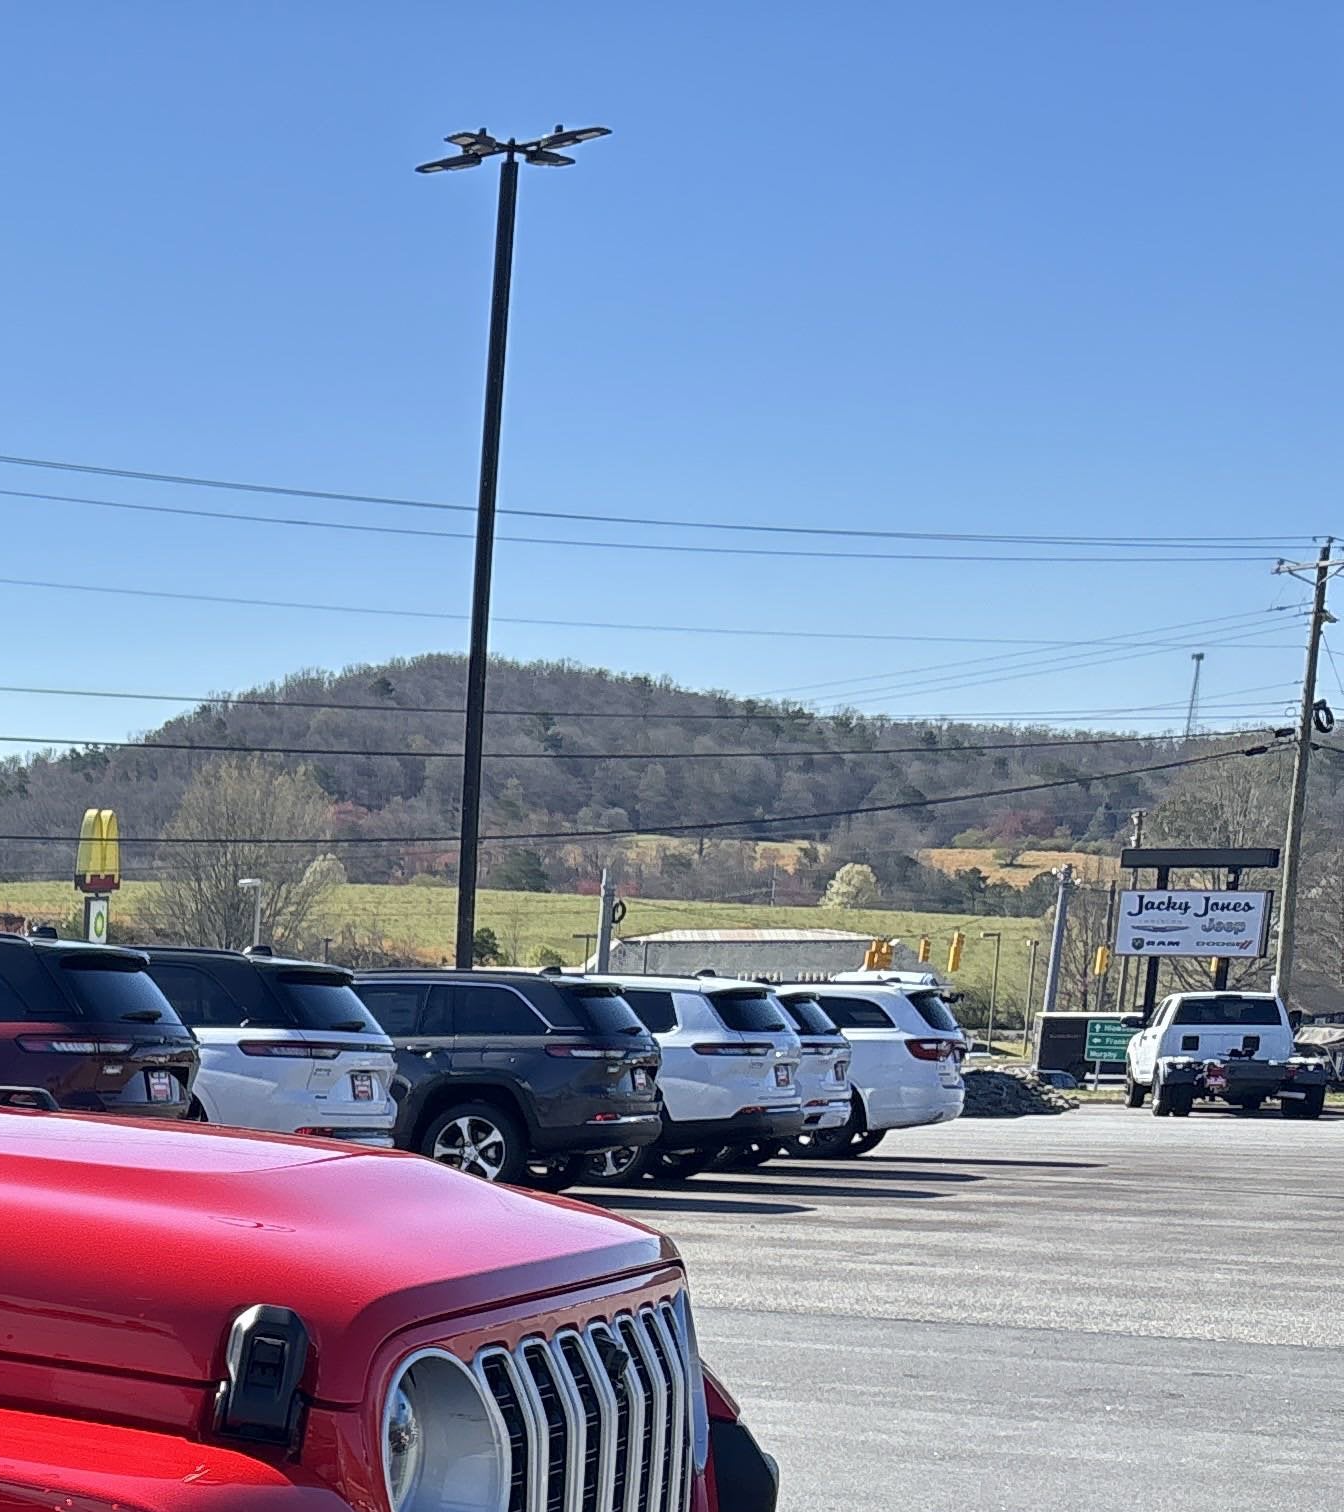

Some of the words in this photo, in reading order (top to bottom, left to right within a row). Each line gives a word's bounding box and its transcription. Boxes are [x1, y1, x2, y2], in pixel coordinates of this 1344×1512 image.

[1126, 894, 1192, 917] Jacky
[1193, 895, 1256, 918] Jones
[1200, 917, 1246, 935] Jeep
